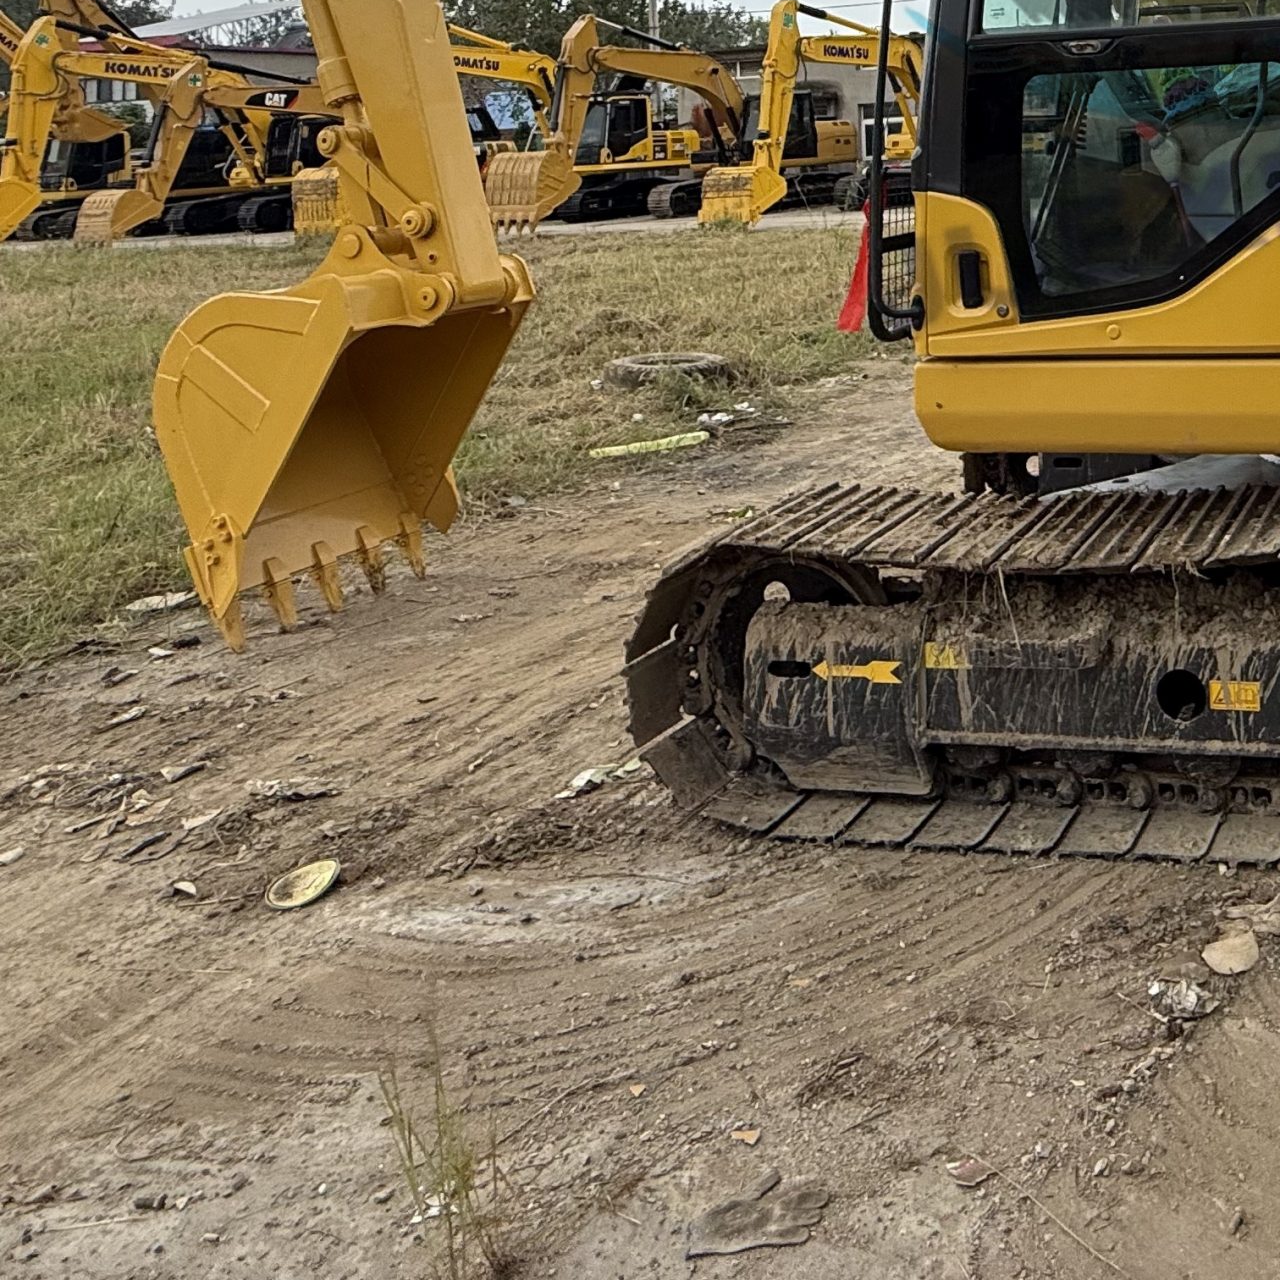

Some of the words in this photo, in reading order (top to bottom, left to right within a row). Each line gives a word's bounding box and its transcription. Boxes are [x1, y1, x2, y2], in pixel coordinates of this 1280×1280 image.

[823, 45, 869, 60] KOMATSU
[453, 56, 500, 71] OMATSU
[264, 92, 288, 107] CAT
